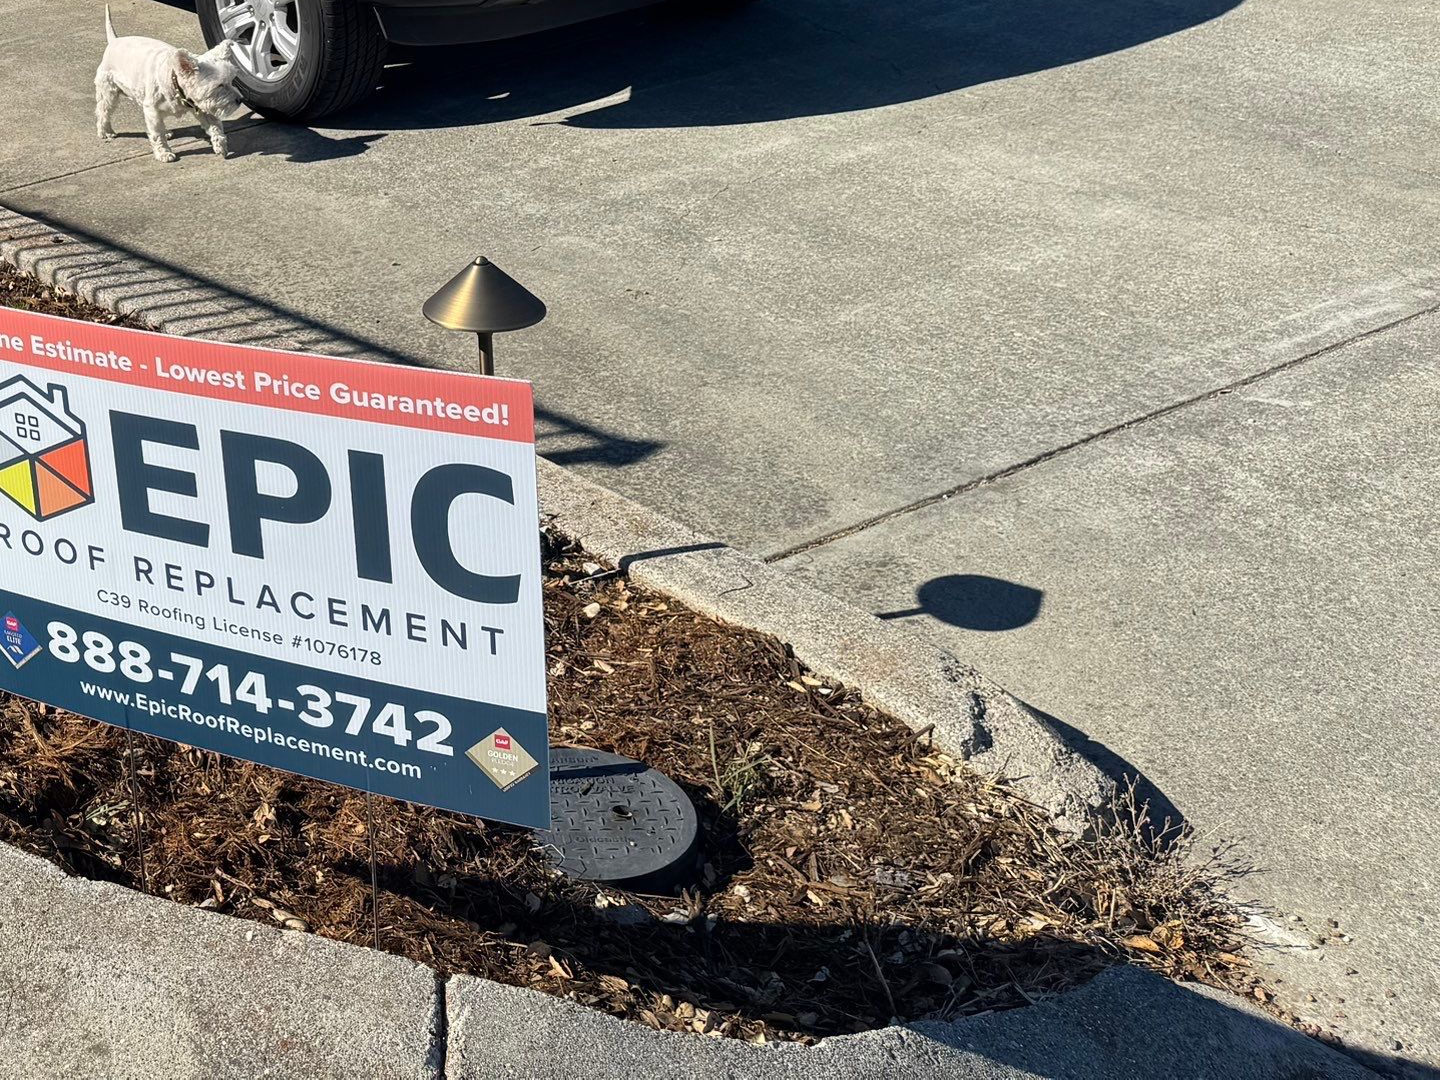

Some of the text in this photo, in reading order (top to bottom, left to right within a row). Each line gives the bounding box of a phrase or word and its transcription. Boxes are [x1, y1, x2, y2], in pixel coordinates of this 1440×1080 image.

[30, 336, 132, 371] Estimate
[155, 357, 246, 390] Lowest
[254, 372, 321, 400] Price
[329, 382, 510, 426] Guaranteed!
[108, 409, 522, 604] EPIC
[97, 589, 382, 665] C39 Roofing License #1076178
[133, 555, 505, 655] REPLACEMENT
[46, 621, 454, 756] 888-714-3742
[80, 680, 422, 779] www.EpicRoofReplacement.com
[487, 749, 519, 762] GOLDEN
